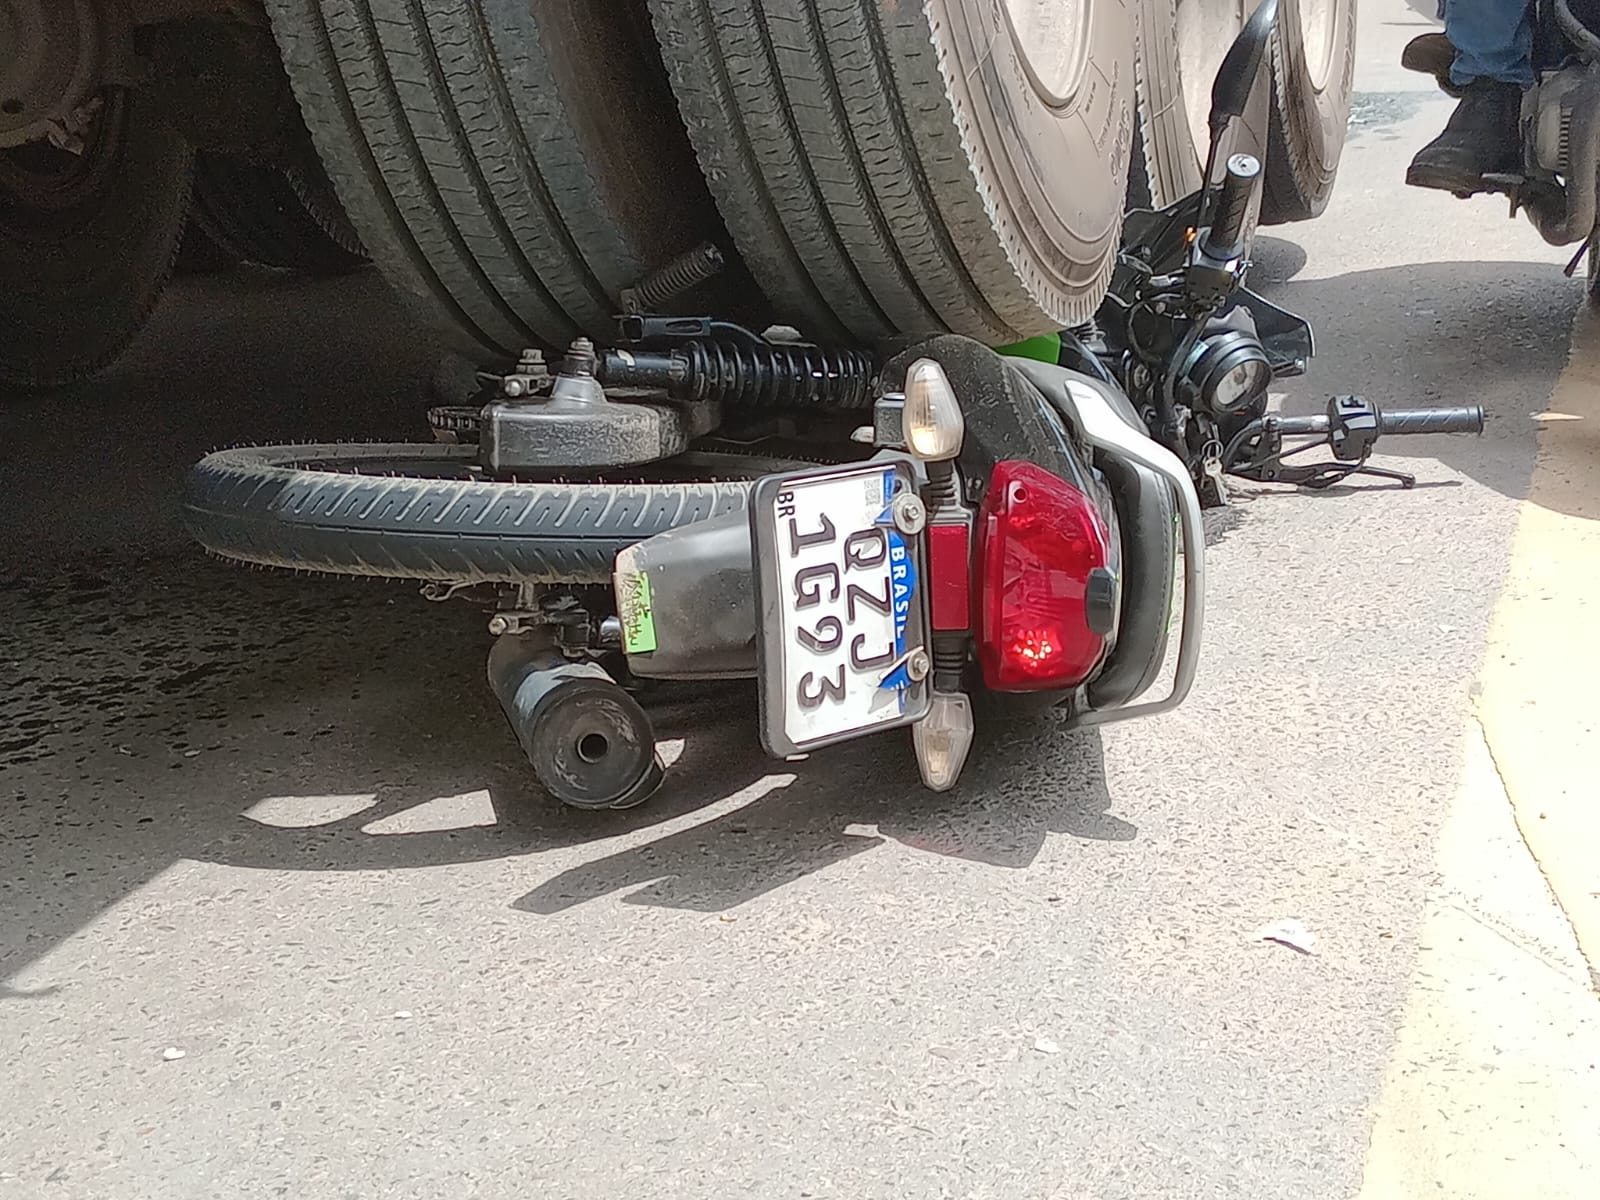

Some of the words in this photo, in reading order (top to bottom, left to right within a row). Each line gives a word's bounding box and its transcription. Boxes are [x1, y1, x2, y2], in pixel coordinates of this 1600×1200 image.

[776, 491, 796, 518] BR
[789, 512, 846, 709] 1G93
[844, 527, 893, 670] QZJ
[890, 546, 907, 639] BRASIL
